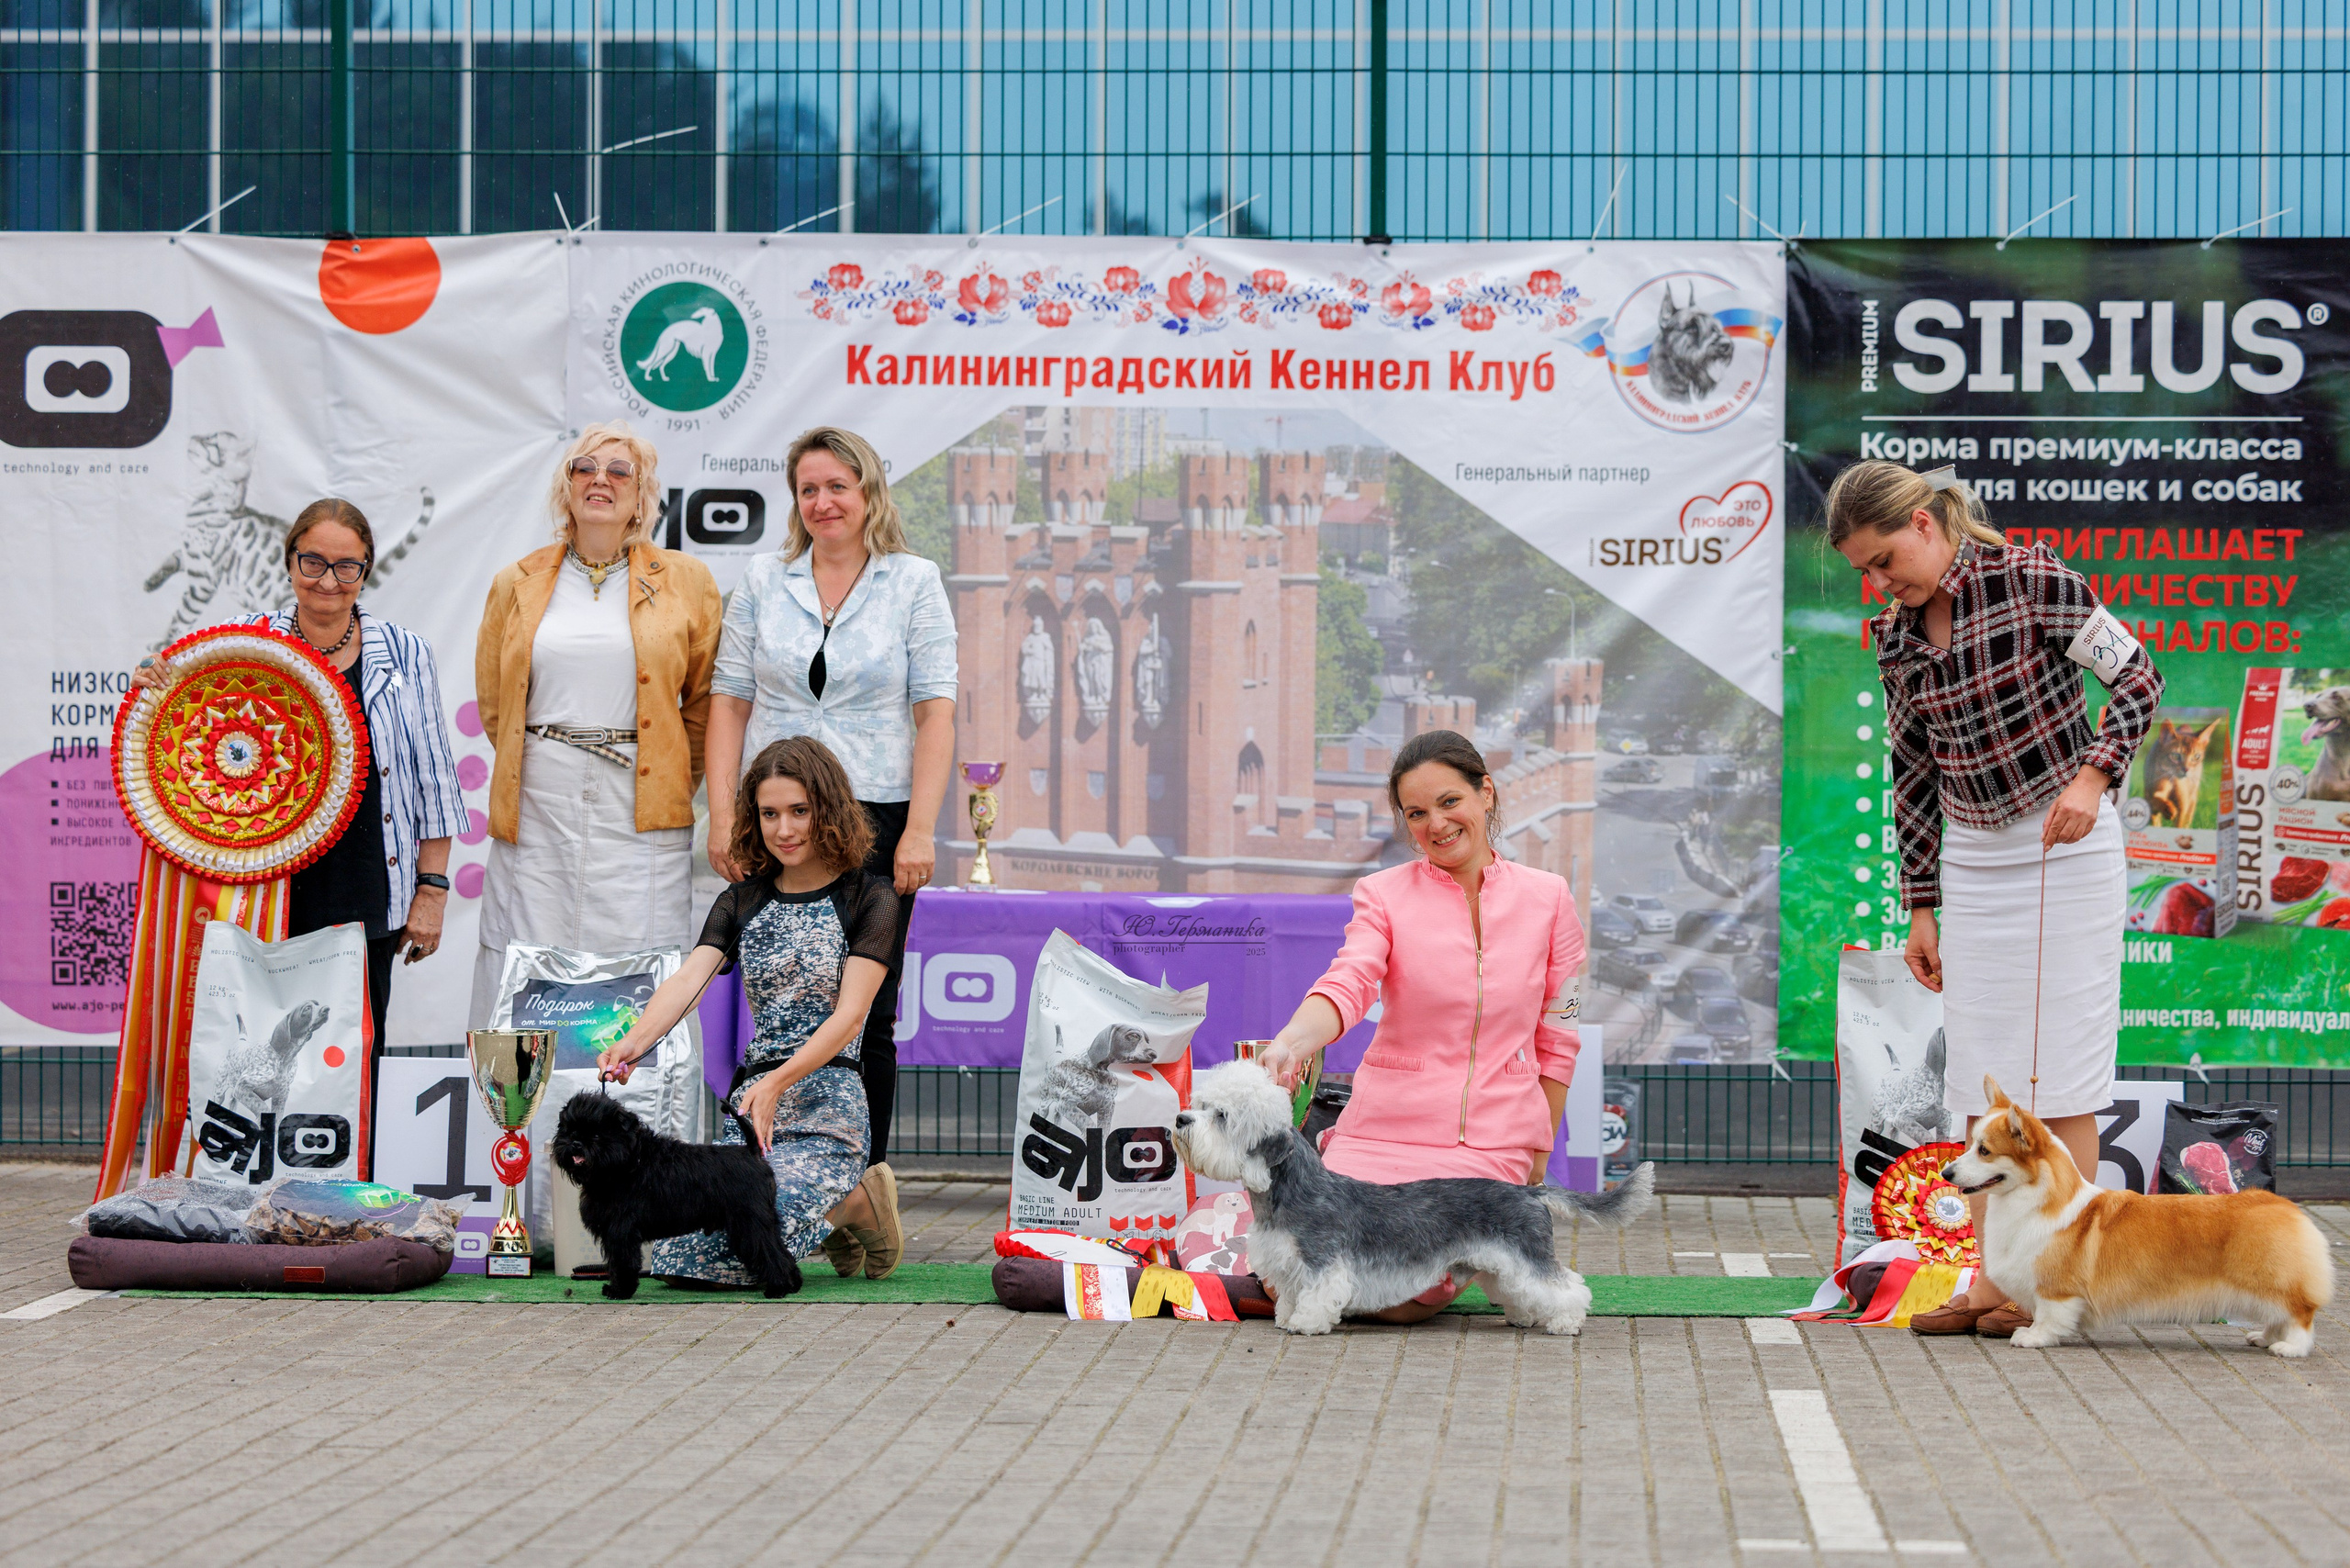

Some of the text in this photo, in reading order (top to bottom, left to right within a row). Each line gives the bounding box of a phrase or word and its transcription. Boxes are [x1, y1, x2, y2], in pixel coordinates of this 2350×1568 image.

[602, 262, 769, 420] РОССИЙСКАЯ КИНОЛОГИЧЕСКАЯ ФЕДЕРАЦИЯ
[1861, 299, 1879, 392] PREMIUM
[846, 344, 1555, 401] Калининградский Кеннел Клуб
[666, 419, 700, 431] 1991
[1861, 431, 2303, 466] Корма премиум-класса
[4, 462, 149, 476] technology and care
[1455, 463, 1651, 485] Генеральный партнер
[1956, 474, 2303, 503] ля кошек и собак
[1733, 499, 1762, 511] ЭТО
[1691, 515, 1755, 529] ЛЮБОВЬ
[2005, 527, 2304, 561] ПРИГЛАШАЕТ
[2083, 616, 2107, 645] SIRIUS
[50, 737, 100, 762] ДЛЯ
[2242, 737, 2268, 749] ADULT
[67, 779, 85, 790] БЕЗ
[67, 817, 114, 828] ВЫСОКОЕ
[2278, 815, 2313, 824] РАЦИОН
[50, 835, 131, 847] ИНГРЕДИЕНТОВ
[210, 949, 358, 975] HOLISTIC VIEW BUCKWHEAT WHEAT/CORN FREE
[1076, 976, 1091, 986] VIEW
[1099, 986, 1113, 997] WITH
[1850, 976, 1878, 986] HOLISTIC
[524, 993, 595, 1018] Подарок
[570, 1018, 598, 1026] КОРМА
[413, 1077, 492, 1202] 1
[1019, 1194, 1055, 1204] BASIC LINE
[1017, 1204, 1102, 1218] MEDIUM ADULT
